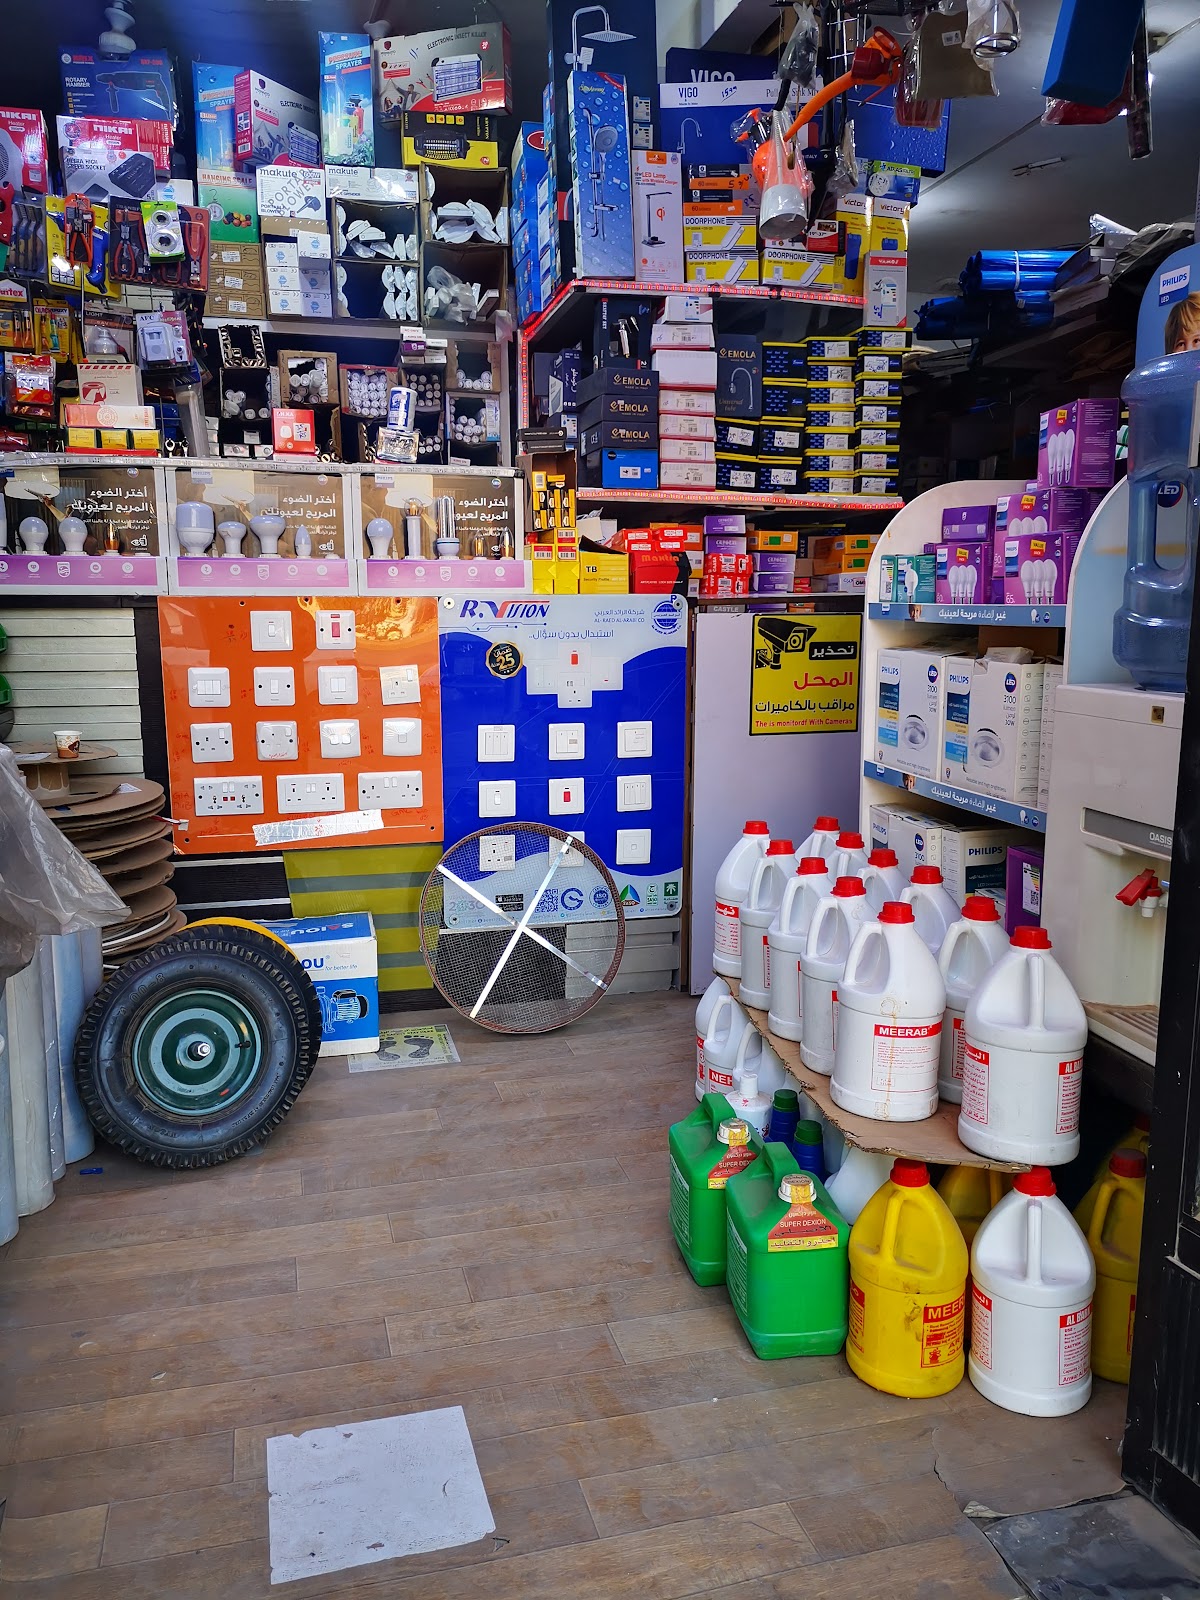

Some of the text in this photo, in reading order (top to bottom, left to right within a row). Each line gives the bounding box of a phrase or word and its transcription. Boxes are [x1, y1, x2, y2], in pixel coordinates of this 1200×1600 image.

[427, 35, 454, 50] ELECTRONIC
[335, 59, 363, 71] SPRAYER
[678, 87, 698, 98] VIGO
[93, 124, 133, 135] NIKAI
[259, 168, 298, 178] makute
[328, 168, 359, 176] makute
[685, 217, 725, 225] DOORPHONE
[767, 252, 806, 261] DOORPHONE
[1162, 273, 1188, 287] PHILIPS
[727, 350, 756, 359] EMOLA
[622, 377, 652, 386] EMOLA
[618, 404, 649, 413] EMOLA
[620, 431, 650, 439] EMOLA
[90, 487, 122, 499] الضوء
[1157, 485, 1180, 495] LED
[282, 493, 336, 505] أختر الضوء
[458, 496, 508, 508] أختر الضوء
[115, 502, 148, 513] المريح
[305, 508, 336, 519] المريح
[480, 511, 508, 522] المريح
[585, 565, 598, 573] TB
[713, 605, 739, 613] CASTLE
[960, 610, 977, 620] مريحة
[994, 612, 1007, 621] غير
[557, 630, 580, 640] بدون
[579, 629, 614, 639] استبدال
[811, 645, 855, 658] تحذير
[498, 654, 515, 670] 25
[881, 666, 899, 676] PHILIPS
[793, 671, 853, 691] المحل
[949, 674, 969, 685] PHILIPS
[1003, 694, 1016, 704] 3100
[755, 698, 855, 714] مراقب بالكاميرات
[951, 792, 969, 805] مريحة
[985, 804, 997, 813] غير
[872, 822, 887, 836] PHILIPS
[915, 838, 924, 846] LED
[1149, 831, 1173, 846] OASIS
[968, 846, 1003, 856] PHILIPS
[879, 1027, 928, 1037] MEERAB
[1064, 1064, 1072, 1073] AL
[780, 1219, 827, 1228] SUPER DEXION
[1066, 1315, 1075, 1326] AL
